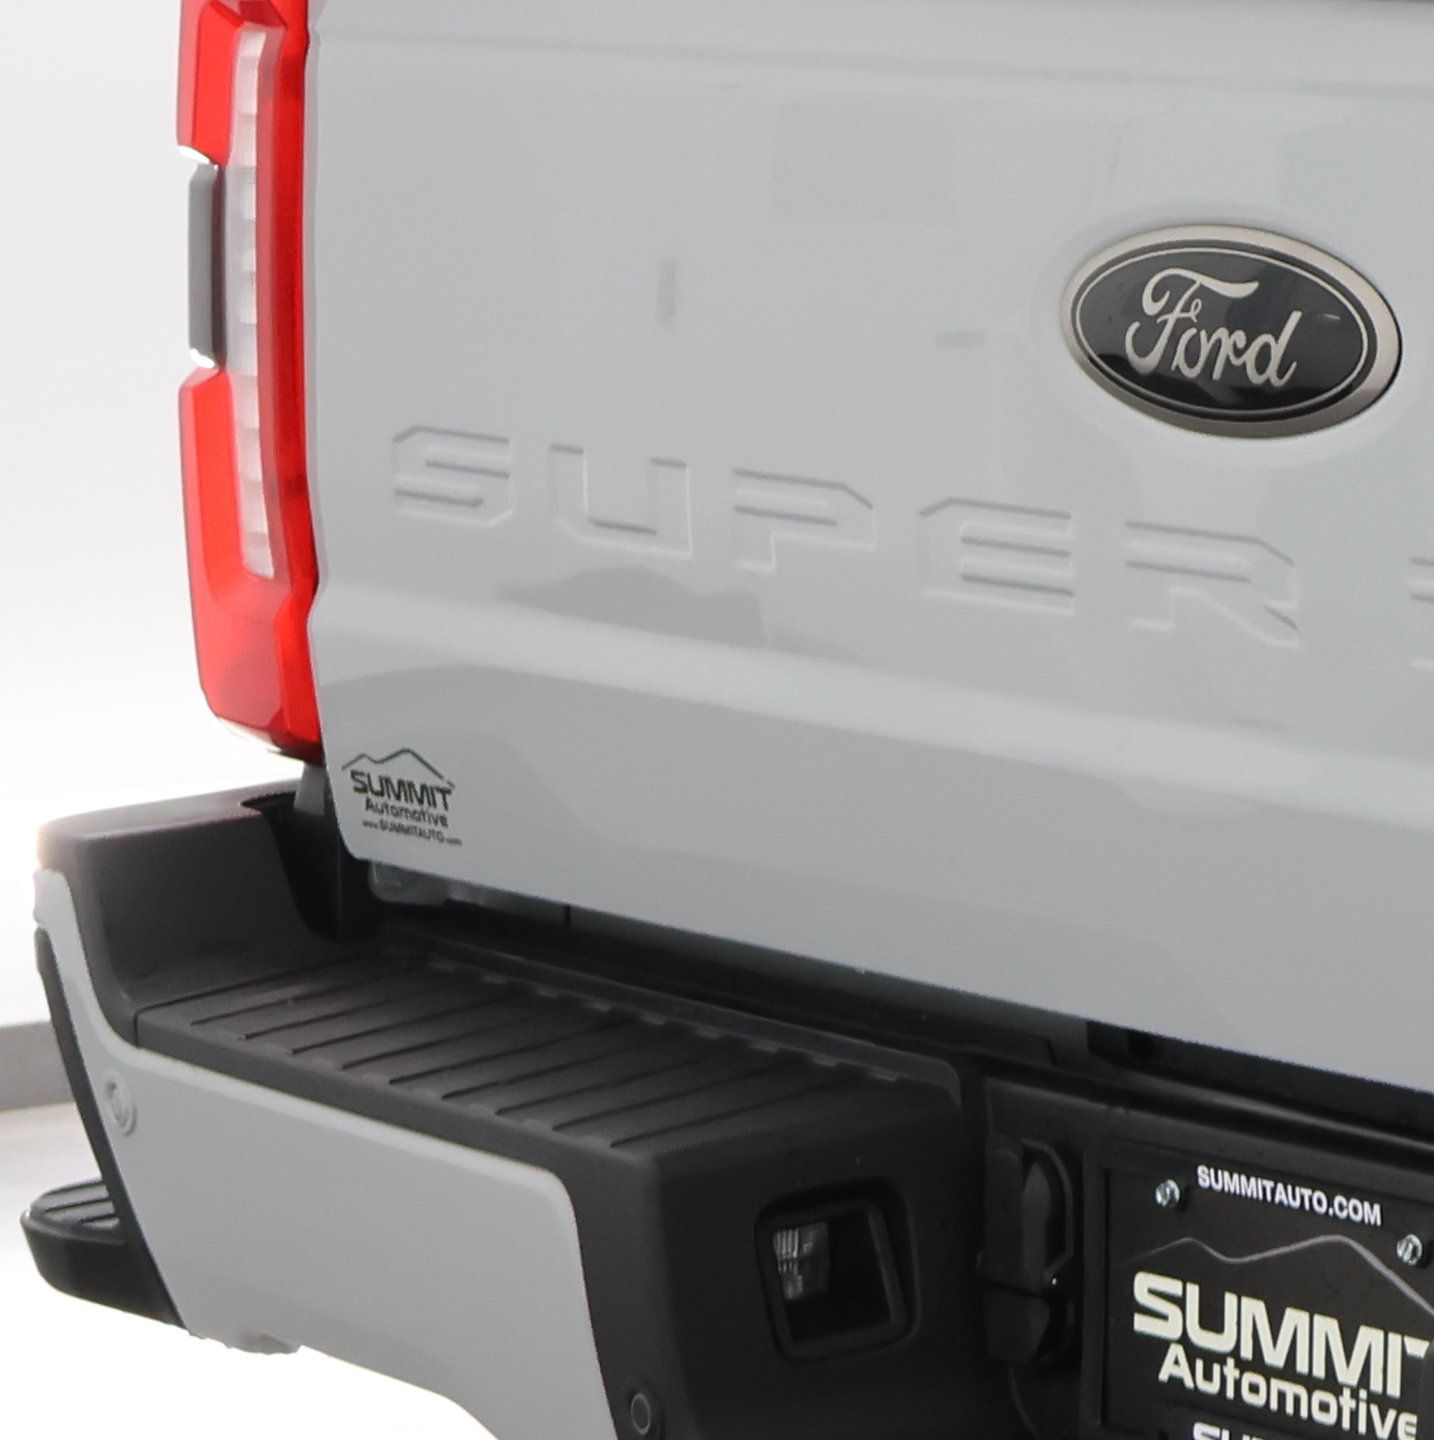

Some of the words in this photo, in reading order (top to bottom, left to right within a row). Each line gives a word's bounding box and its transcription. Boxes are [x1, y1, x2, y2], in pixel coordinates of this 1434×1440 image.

[1124, 267, 1303, 388] Ford
[392, 426, 1300, 648] SUPER
[350, 769, 454, 811] SUMMIT
[364, 797, 449, 828] Automotive
[1196, 1164, 1383, 1227] SUMMITAUTO.COM
